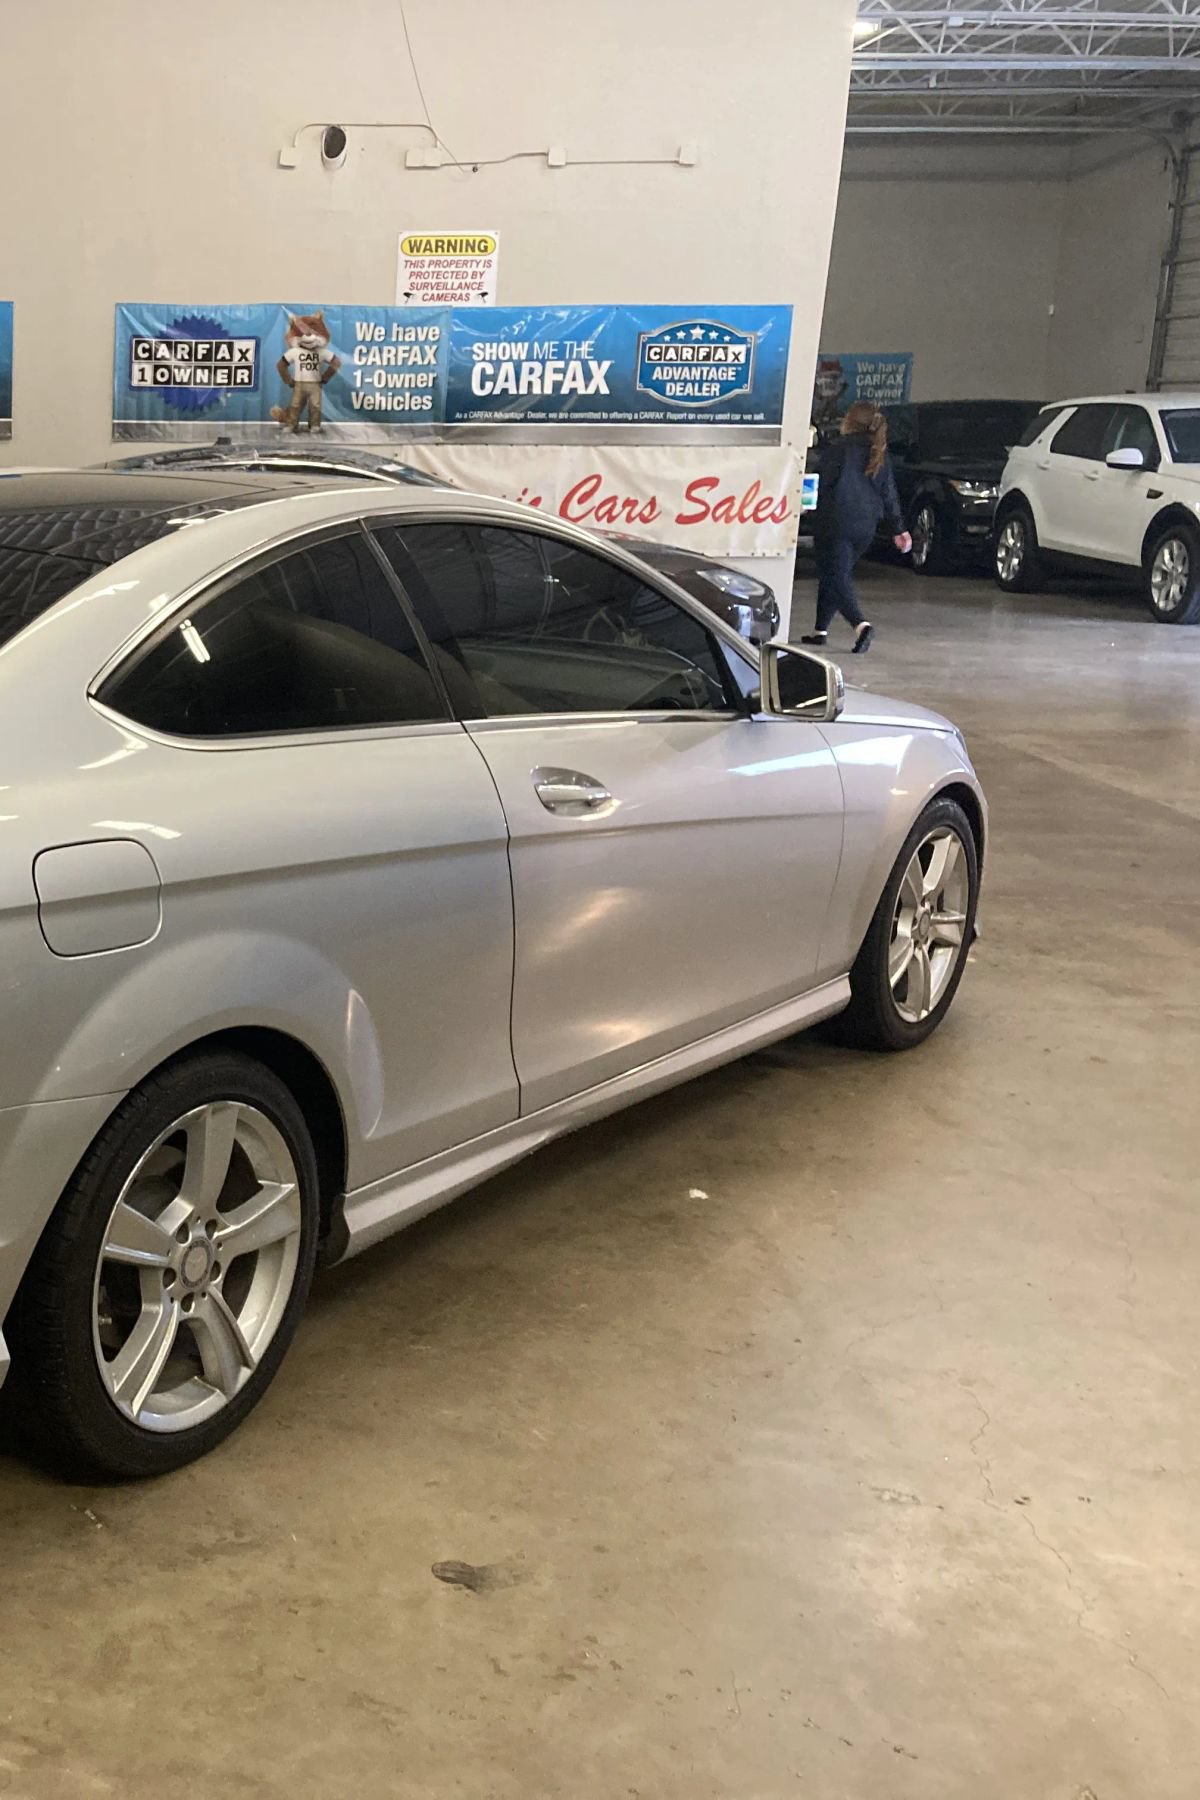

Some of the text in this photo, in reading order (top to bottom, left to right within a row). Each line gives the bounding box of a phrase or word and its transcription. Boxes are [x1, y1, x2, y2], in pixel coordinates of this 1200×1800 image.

[408, 239, 488, 253] WARNING
[404, 260, 492, 269] THIS PROPERTY IS
[409, 271, 485, 280] PROTECTED BY
[409, 282, 484, 291] SURVEILLANCE
[422, 293, 471, 302] CAMERAS
[355, 321, 440, 342] We have
[137, 343, 250, 362] CARFAX
[299, 352, 319, 362] CAR
[354, 345, 438, 365] CARFAX
[472, 341, 594, 360] SHOW ME THE
[649, 347, 741, 362] CARFAX
[300, 362, 319, 372] FOX
[652, 366, 736, 380] ADVANTAGE
[857, 362, 906, 374] We have
[138, 367, 250, 384] 1 OWNER
[353, 369, 437, 388] 1-Owner
[471, 360, 610, 396] CARFAX
[856, 374, 904, 386] CARFAX
[665, 382, 720, 396] DEALER
[856, 388, 903, 398] 1-Owner
[351, 391, 433, 410] Vehicles
[559, 474, 663, 524] Cars
[675, 476, 793, 526] Sales
